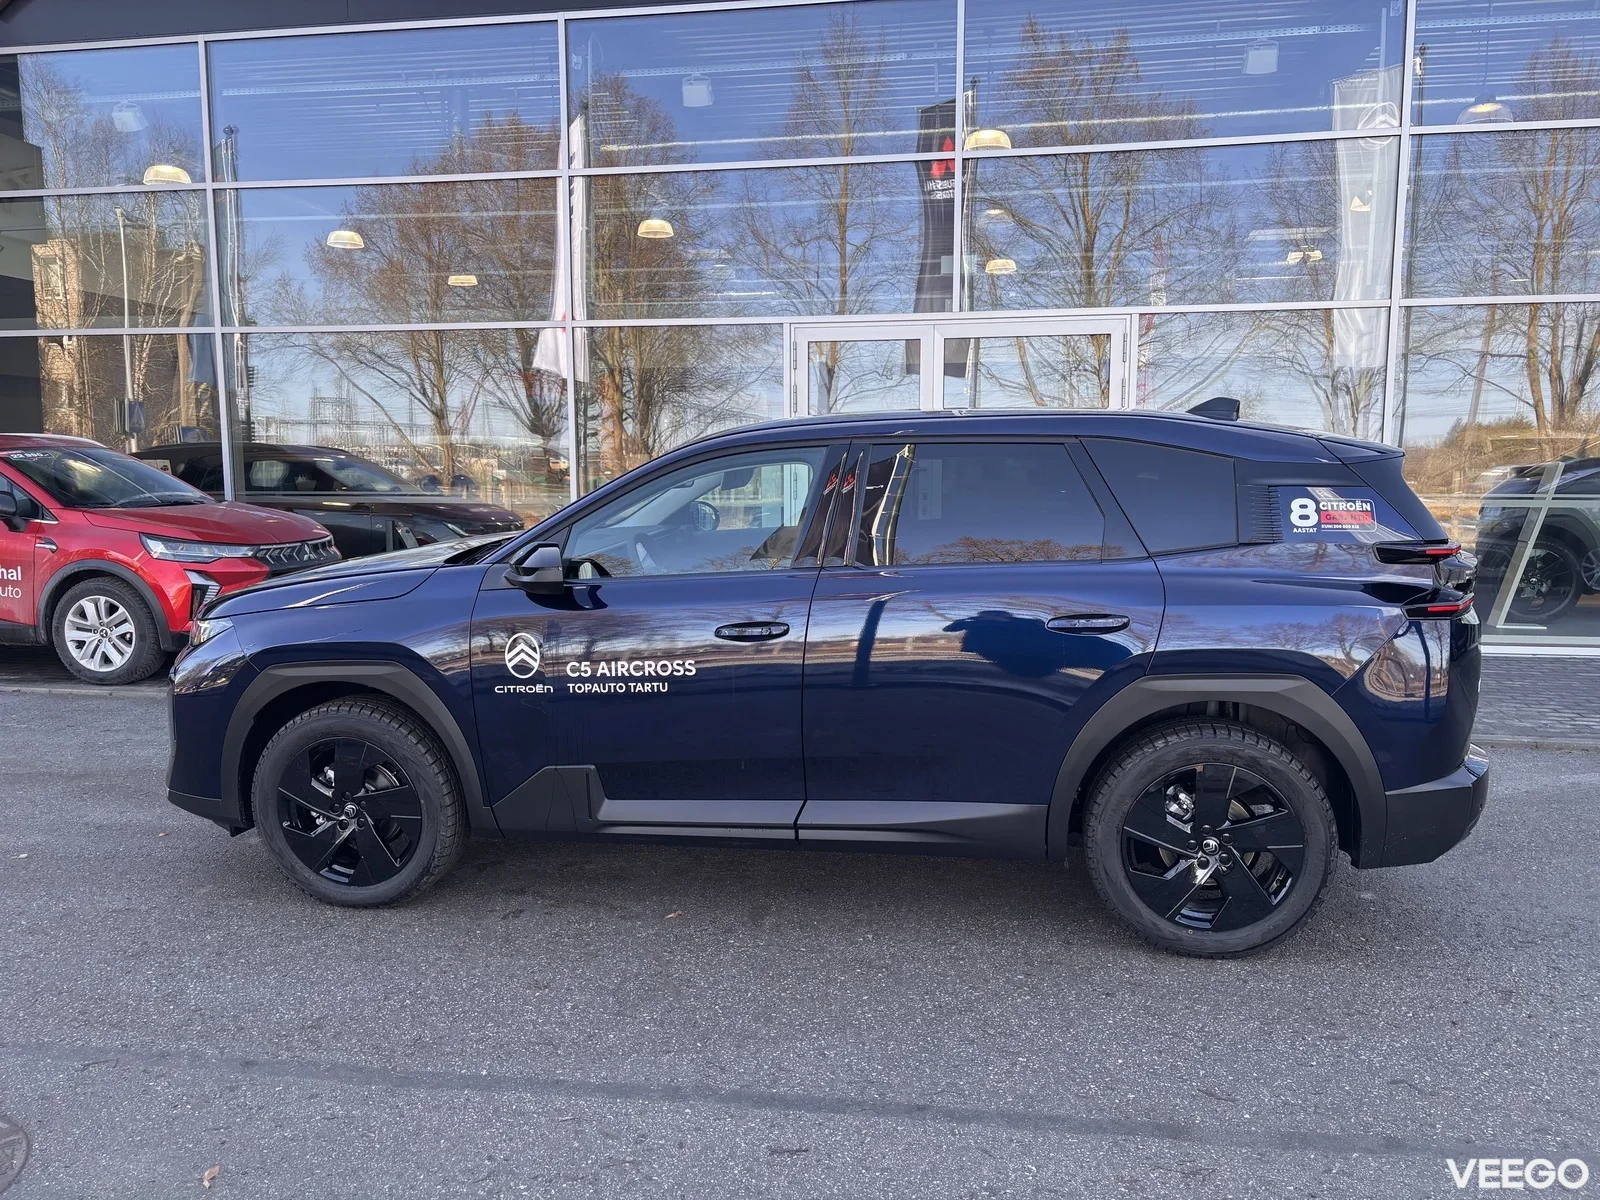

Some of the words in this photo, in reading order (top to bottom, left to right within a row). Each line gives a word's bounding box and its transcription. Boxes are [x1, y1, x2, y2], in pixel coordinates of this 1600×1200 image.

[1290, 498, 1319, 527] 8
[1320, 501, 1371, 511] CITROËN
[566, 661, 592, 677] C5
[596, 660, 697, 677] AIRCROSS
[567, 682, 626, 694] TOPAUTO
[628, 682, 668, 693] TARTU
